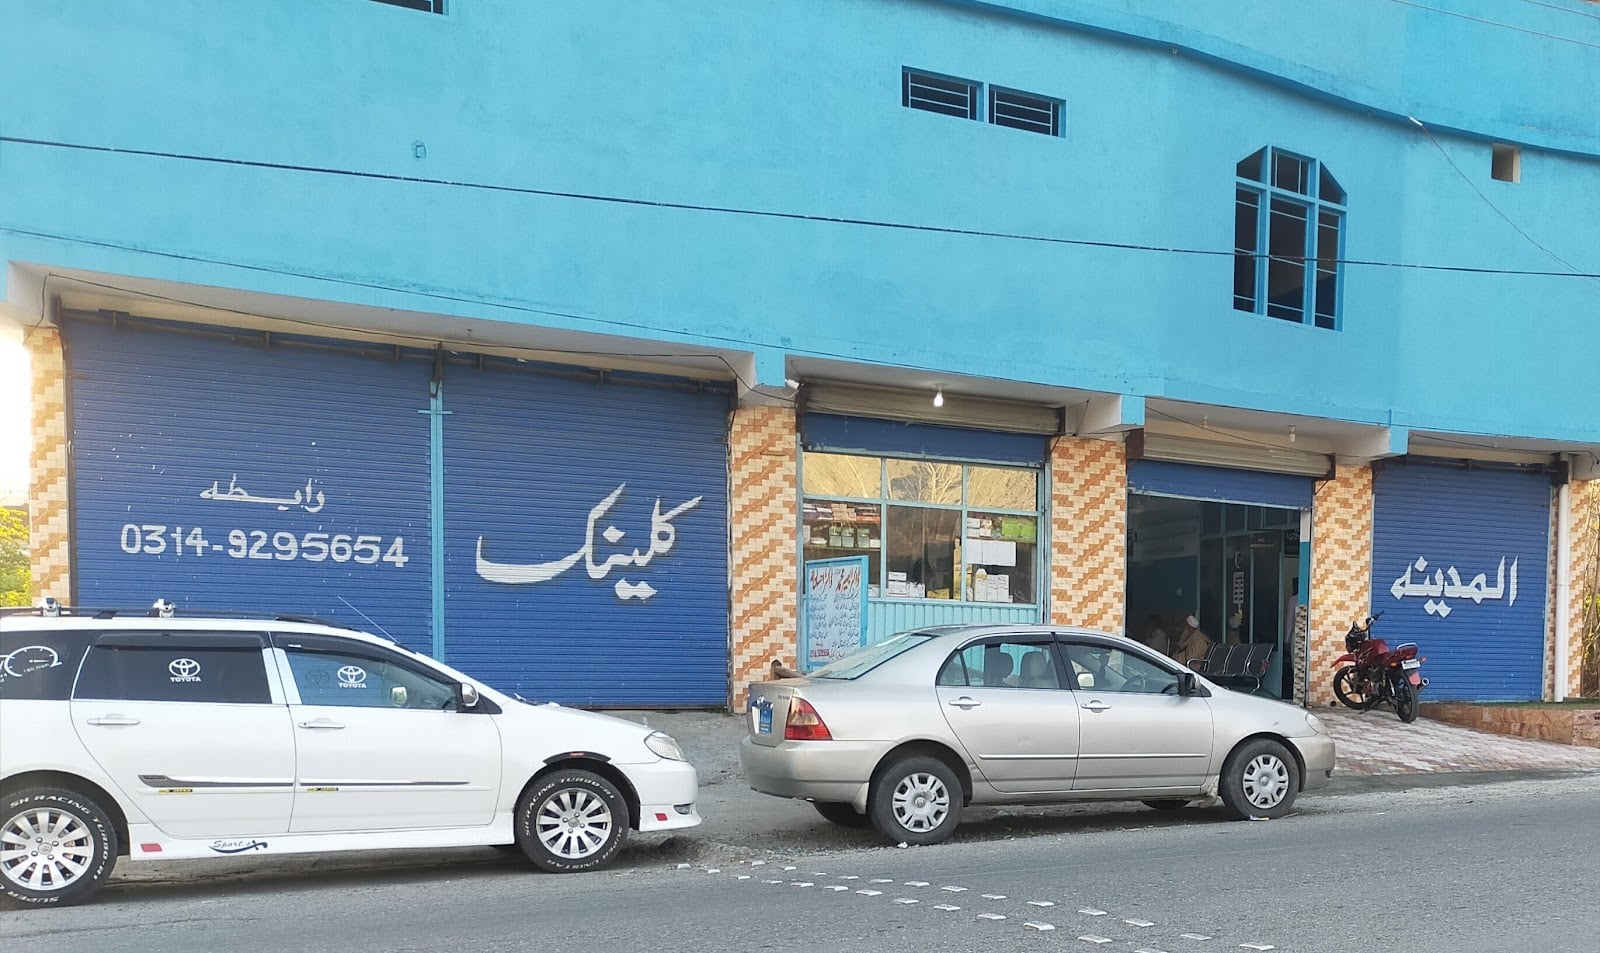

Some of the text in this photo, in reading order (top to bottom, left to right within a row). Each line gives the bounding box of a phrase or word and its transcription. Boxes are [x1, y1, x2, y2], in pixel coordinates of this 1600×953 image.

[120, 523, 409, 568] 0314-9295654
[475, 481, 704, 600] کلینک
[1390, 555, 1519, 619] المدینہ
[34, 795, 92, 815] RACING
[526, 783, 556, 821] RACING
[602, 826, 623, 860] SUPER
[7, 891, 60, 904] SUPER
